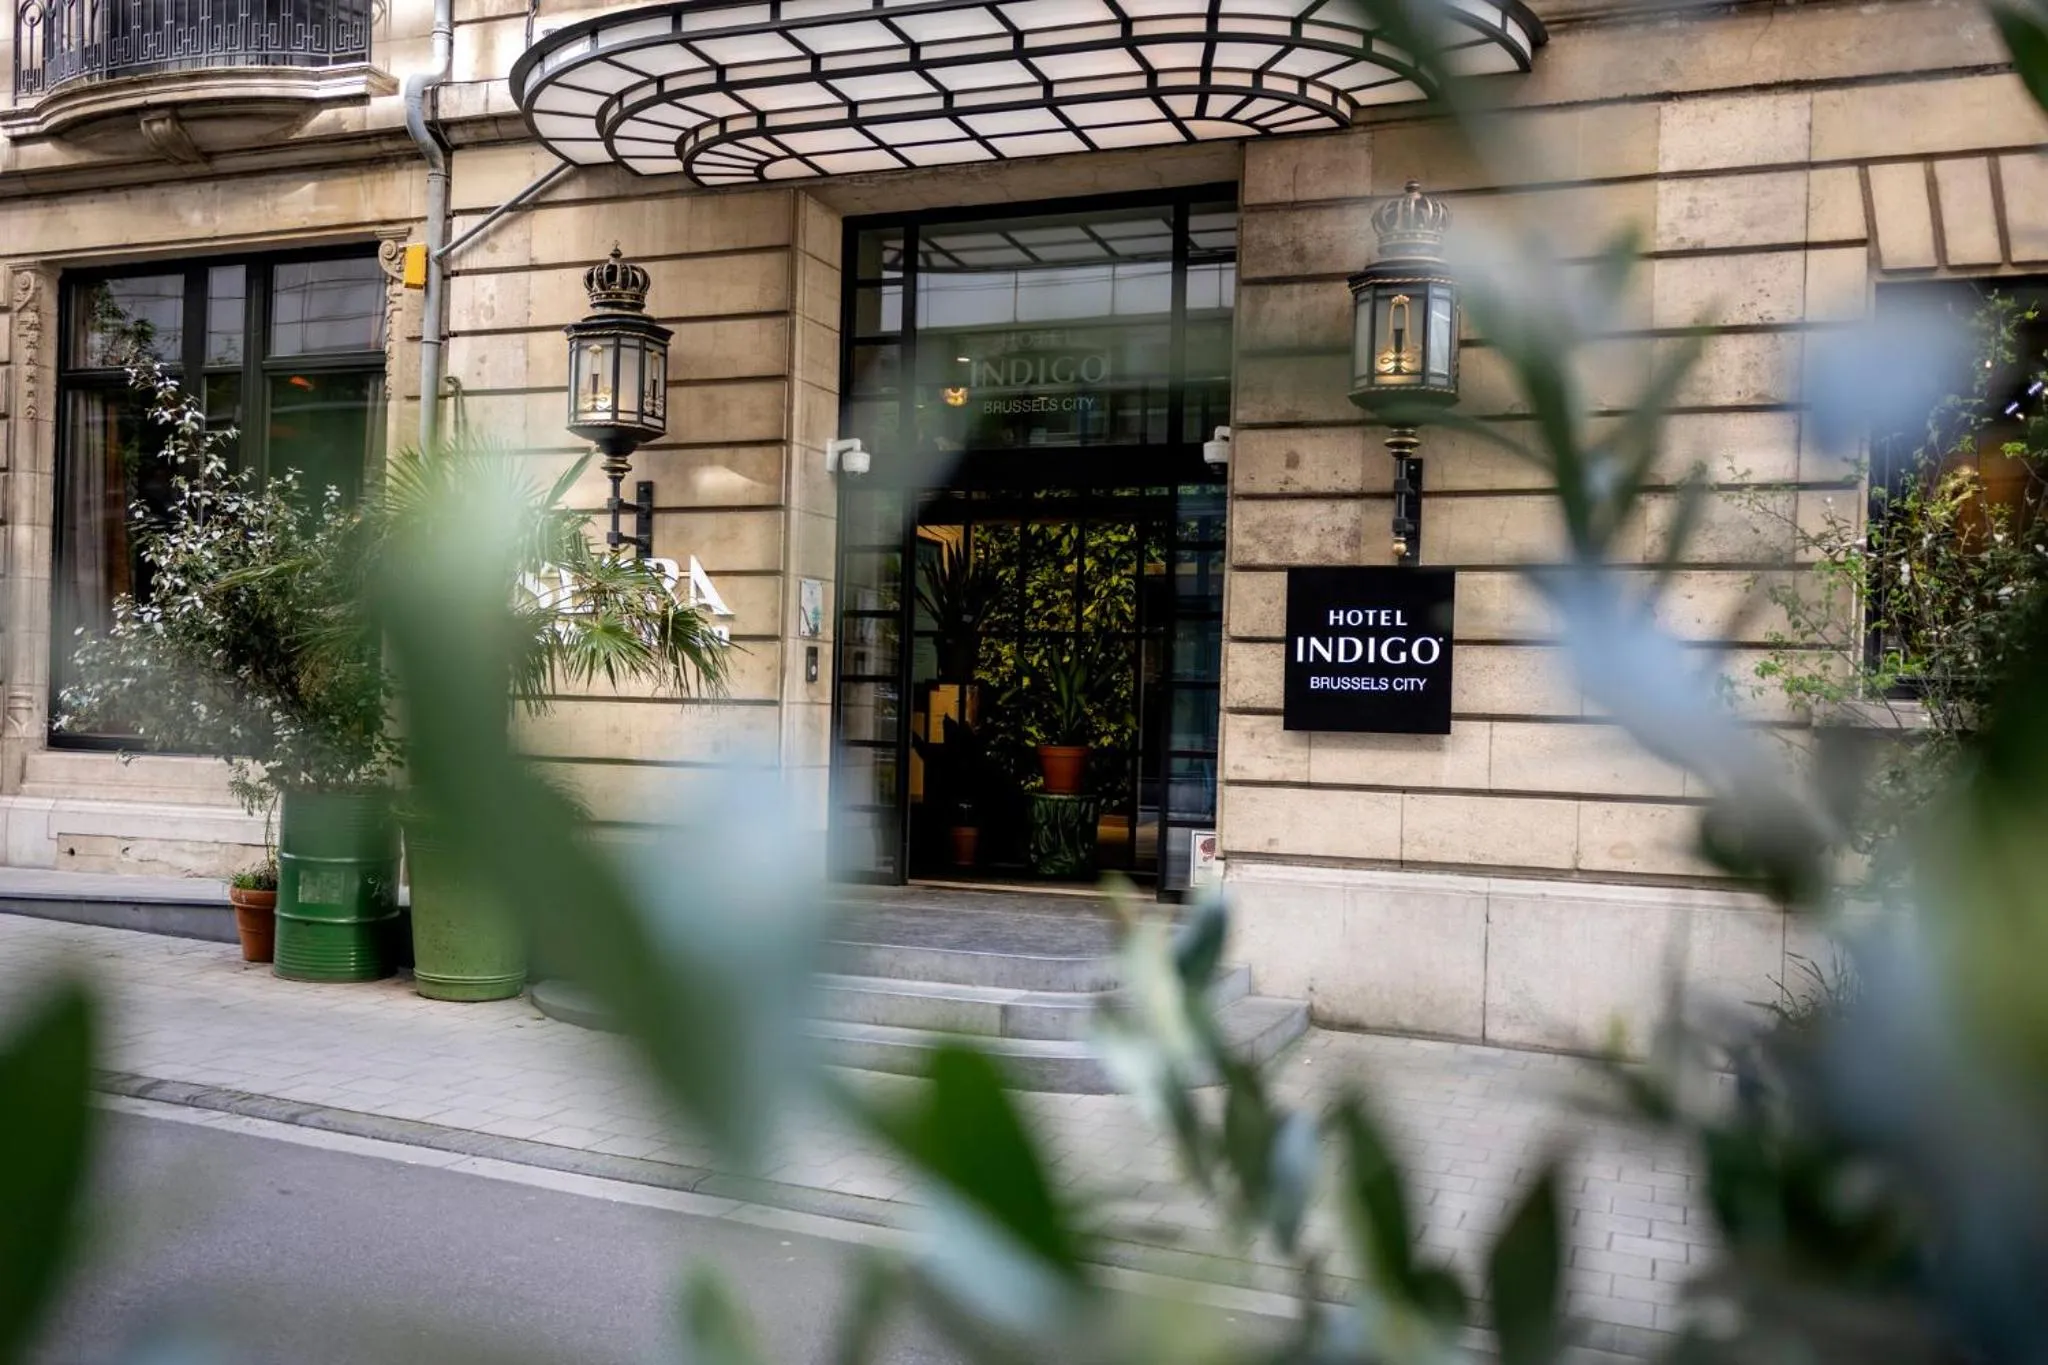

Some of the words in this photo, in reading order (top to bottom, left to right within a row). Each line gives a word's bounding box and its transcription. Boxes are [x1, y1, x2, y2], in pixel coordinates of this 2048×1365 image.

[969, 355, 1107, 388] INDIGO
[983, 397, 1059, 414] BRUSSELS
[1061, 396, 1095, 411] CITY
[1329, 609, 1408, 626] HOTEL
[1296, 636, 1442, 665] INDIGO
[1309, 676, 1389, 691] BRUSSELS
[1392, 677, 1428, 692] CITY
